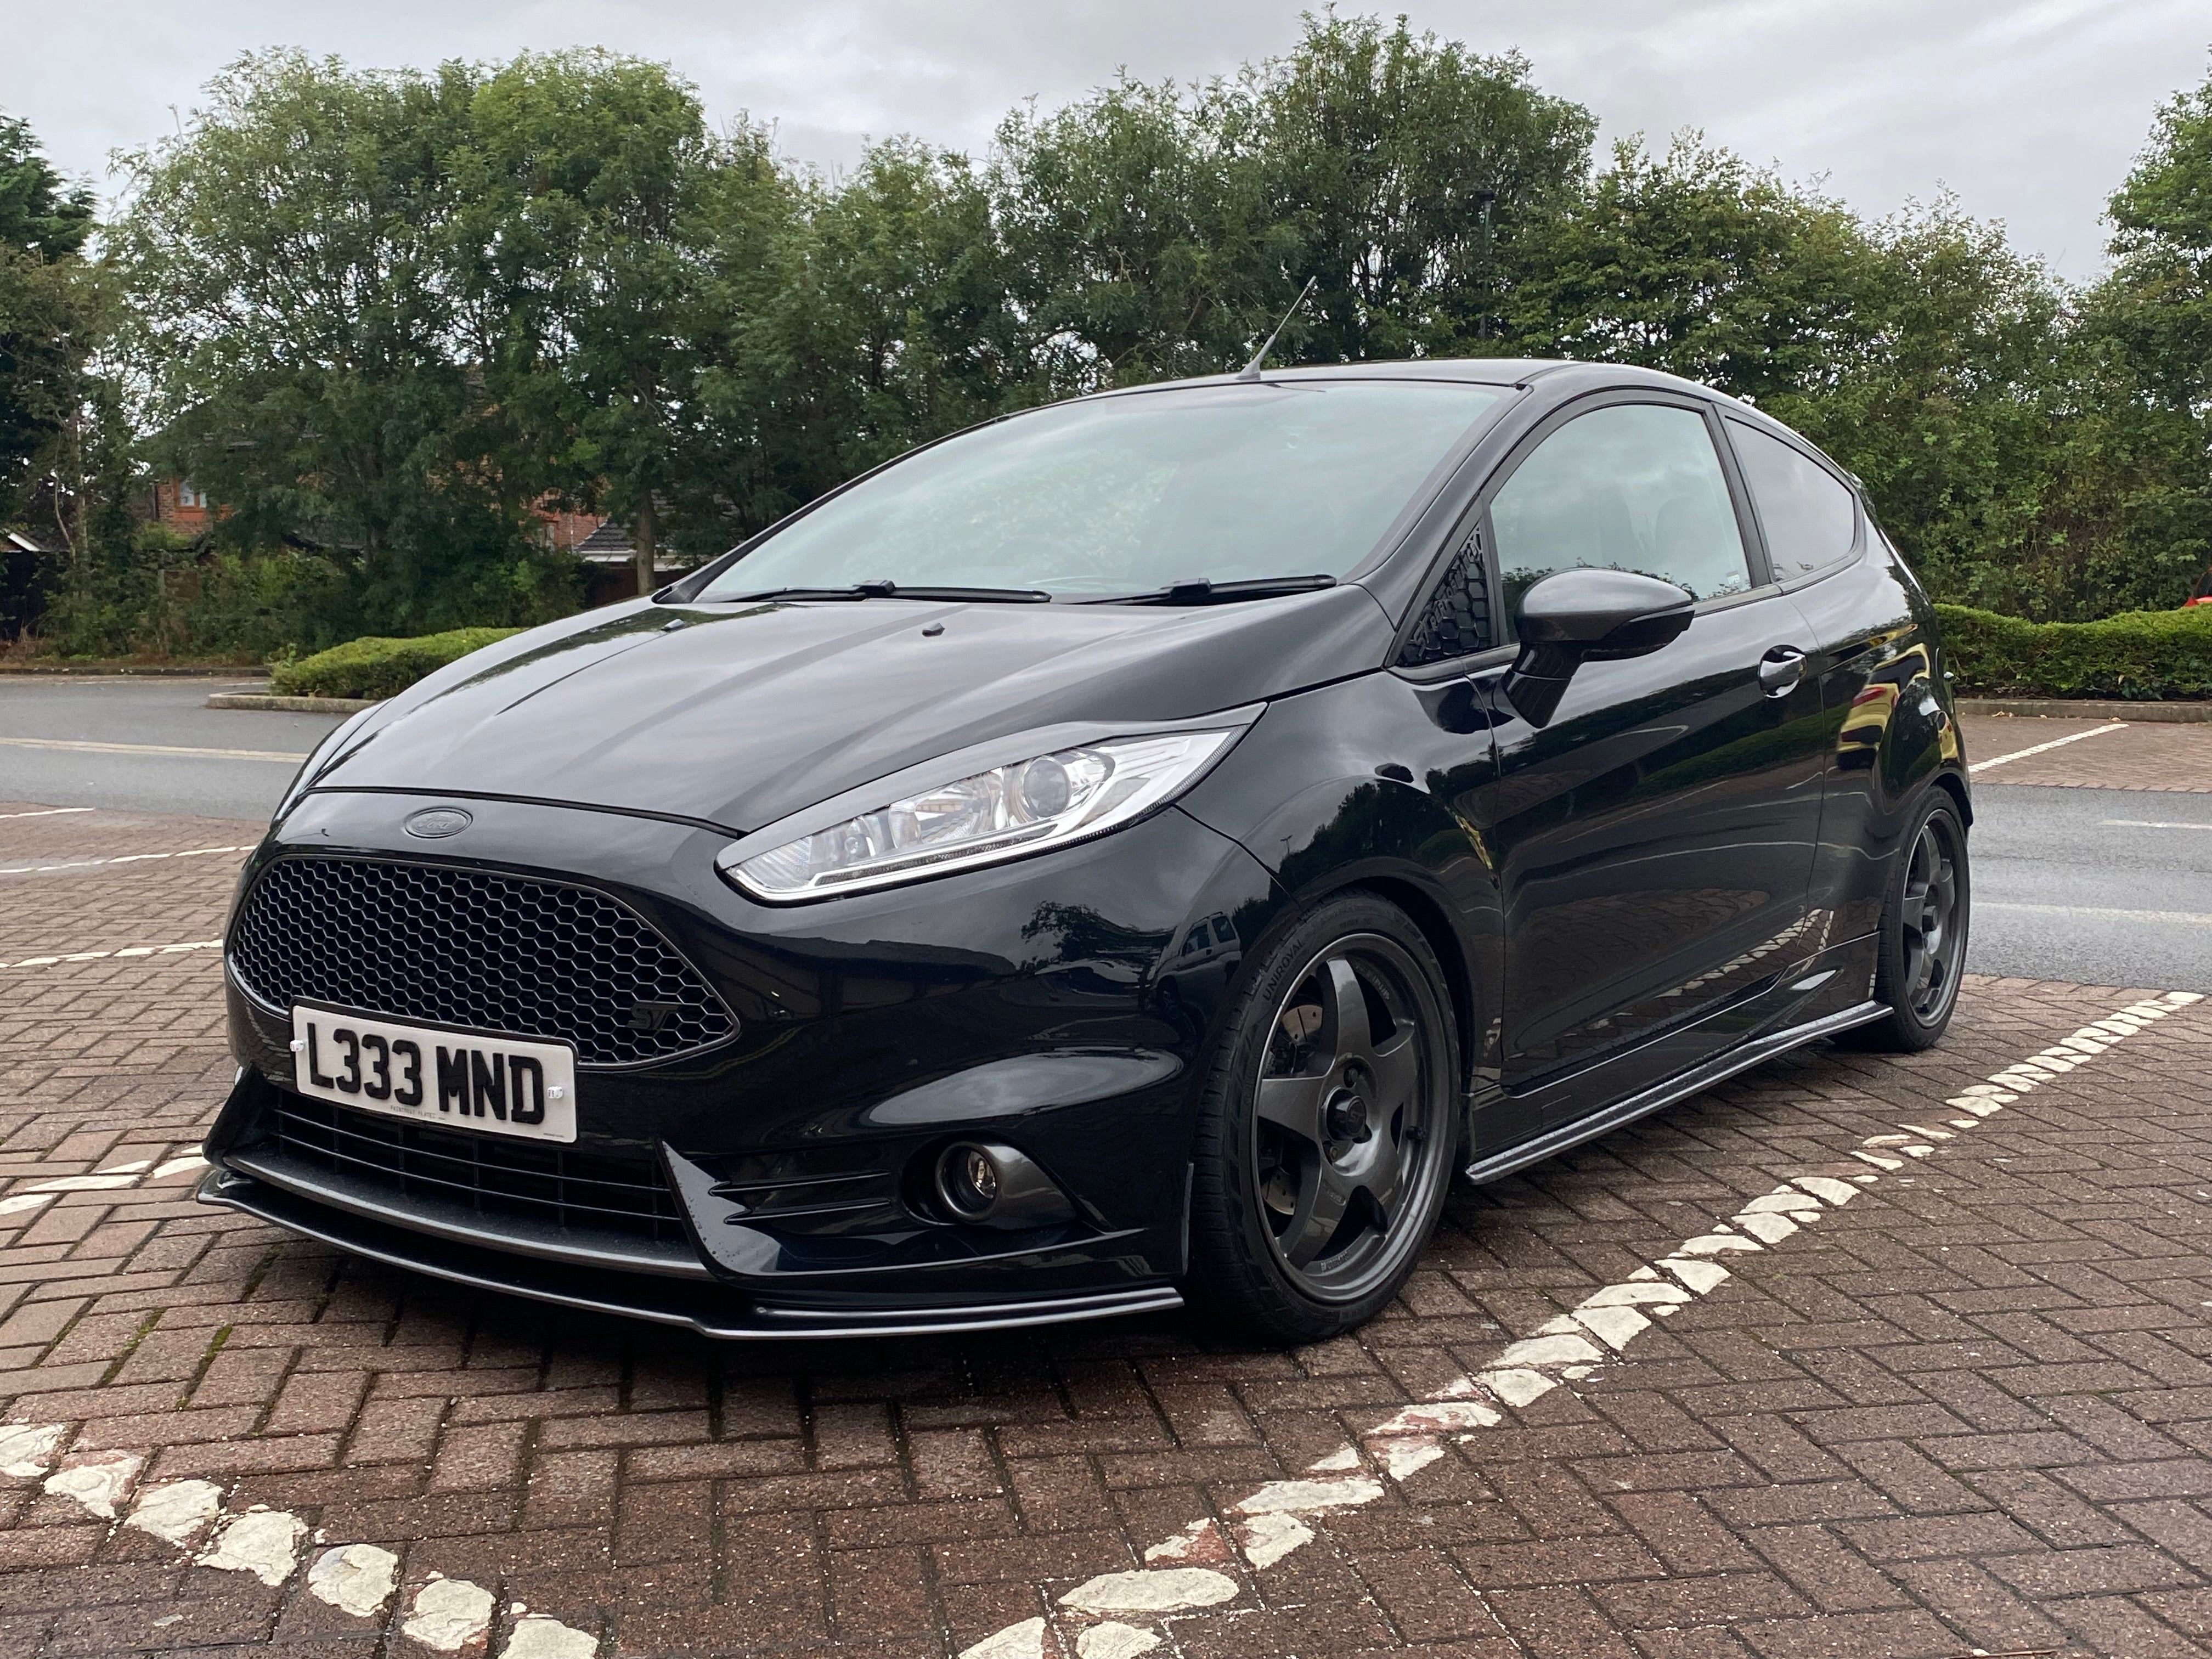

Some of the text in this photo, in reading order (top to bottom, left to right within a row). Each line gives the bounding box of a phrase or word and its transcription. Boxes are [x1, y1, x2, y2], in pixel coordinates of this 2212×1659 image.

[1262, 939, 1306, 1001] UNIROYAL
[626, 1002, 679, 1030] ST
[307, 1023, 545, 1125] L333 MND
